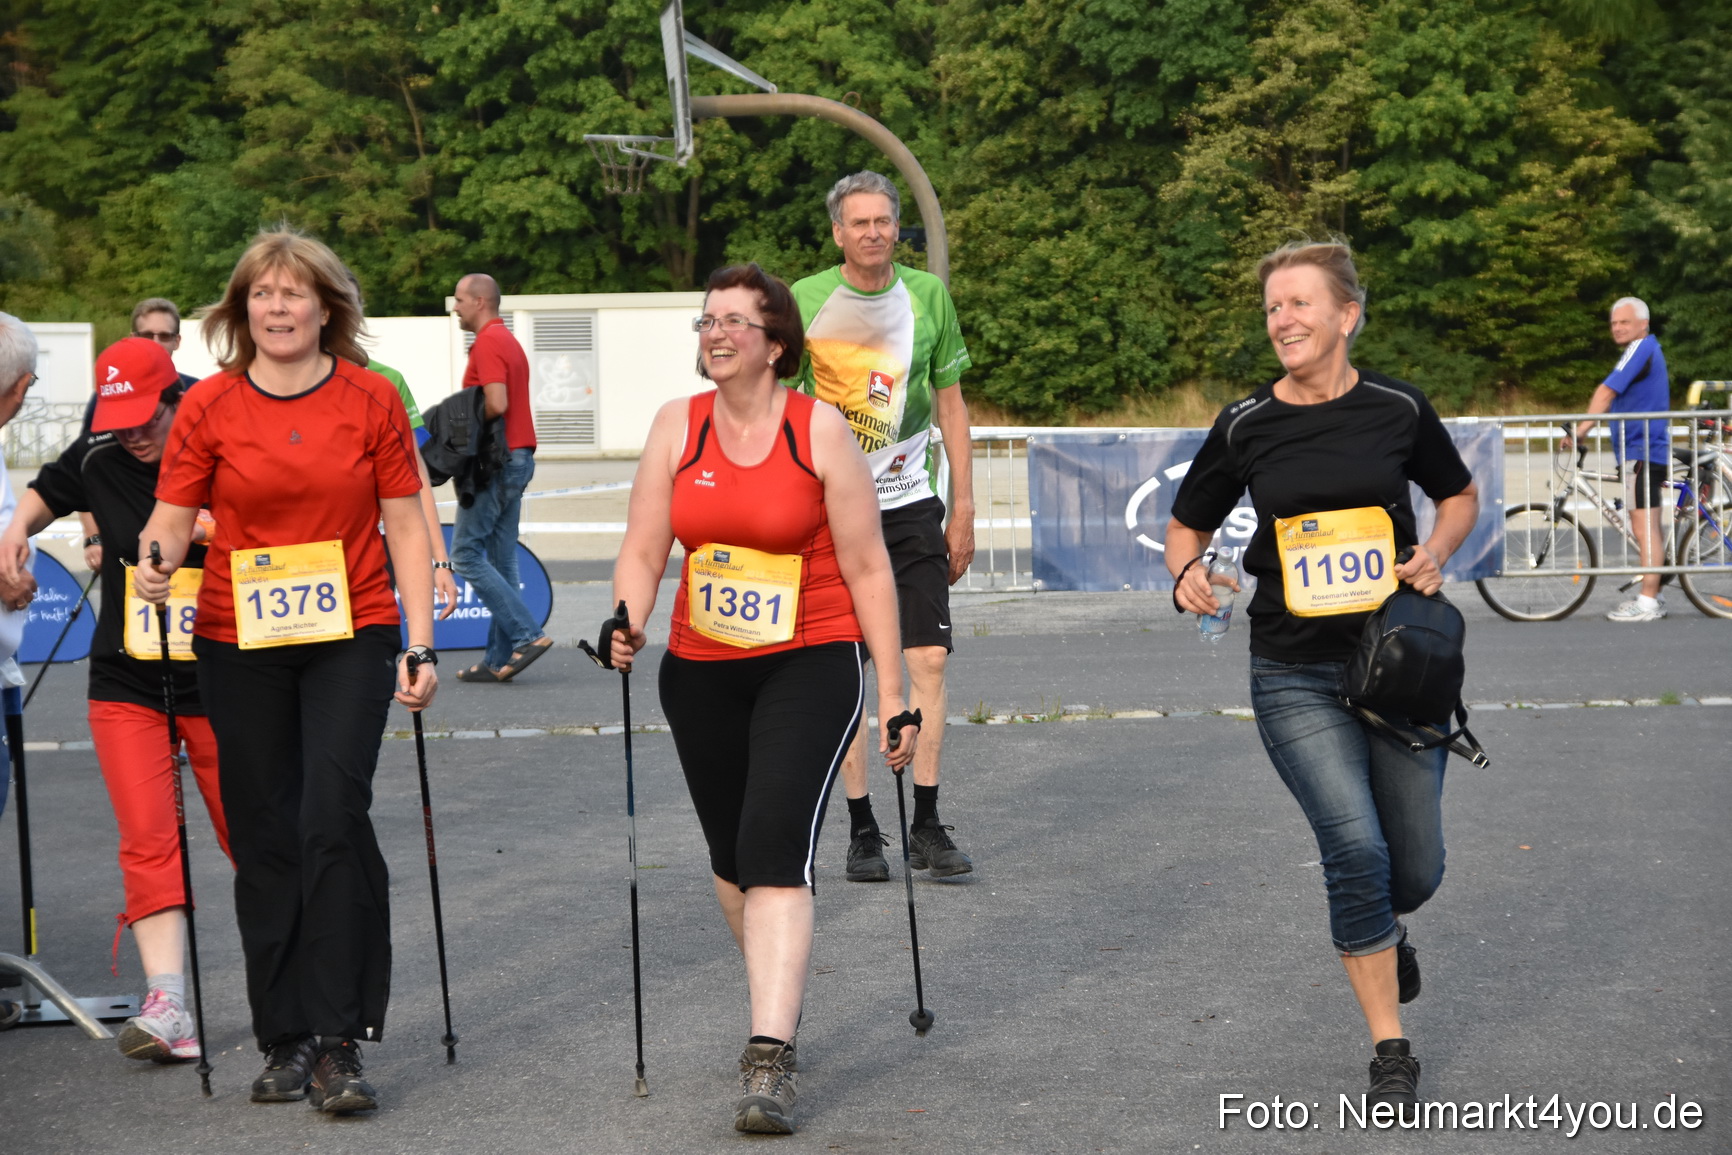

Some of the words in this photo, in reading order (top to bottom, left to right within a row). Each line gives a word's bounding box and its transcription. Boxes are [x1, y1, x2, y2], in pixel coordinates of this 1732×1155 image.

[100, 381, 134, 396] DEKRA
[694, 479, 715, 487] erima
[1294, 548, 1385, 588] 1190
[247, 582, 338, 619] 1378
[1311, 592, 1349, 601] Rosemarie
[1349, 588, 1372, 597] Weber
[699, 582, 782, 625] 1381
[271, 623, 292, 633] Agnes
[292, 622, 317, 630] Richter
[713, 619, 730, 631] Petra
[729, 623, 761, 637] Wittmann
